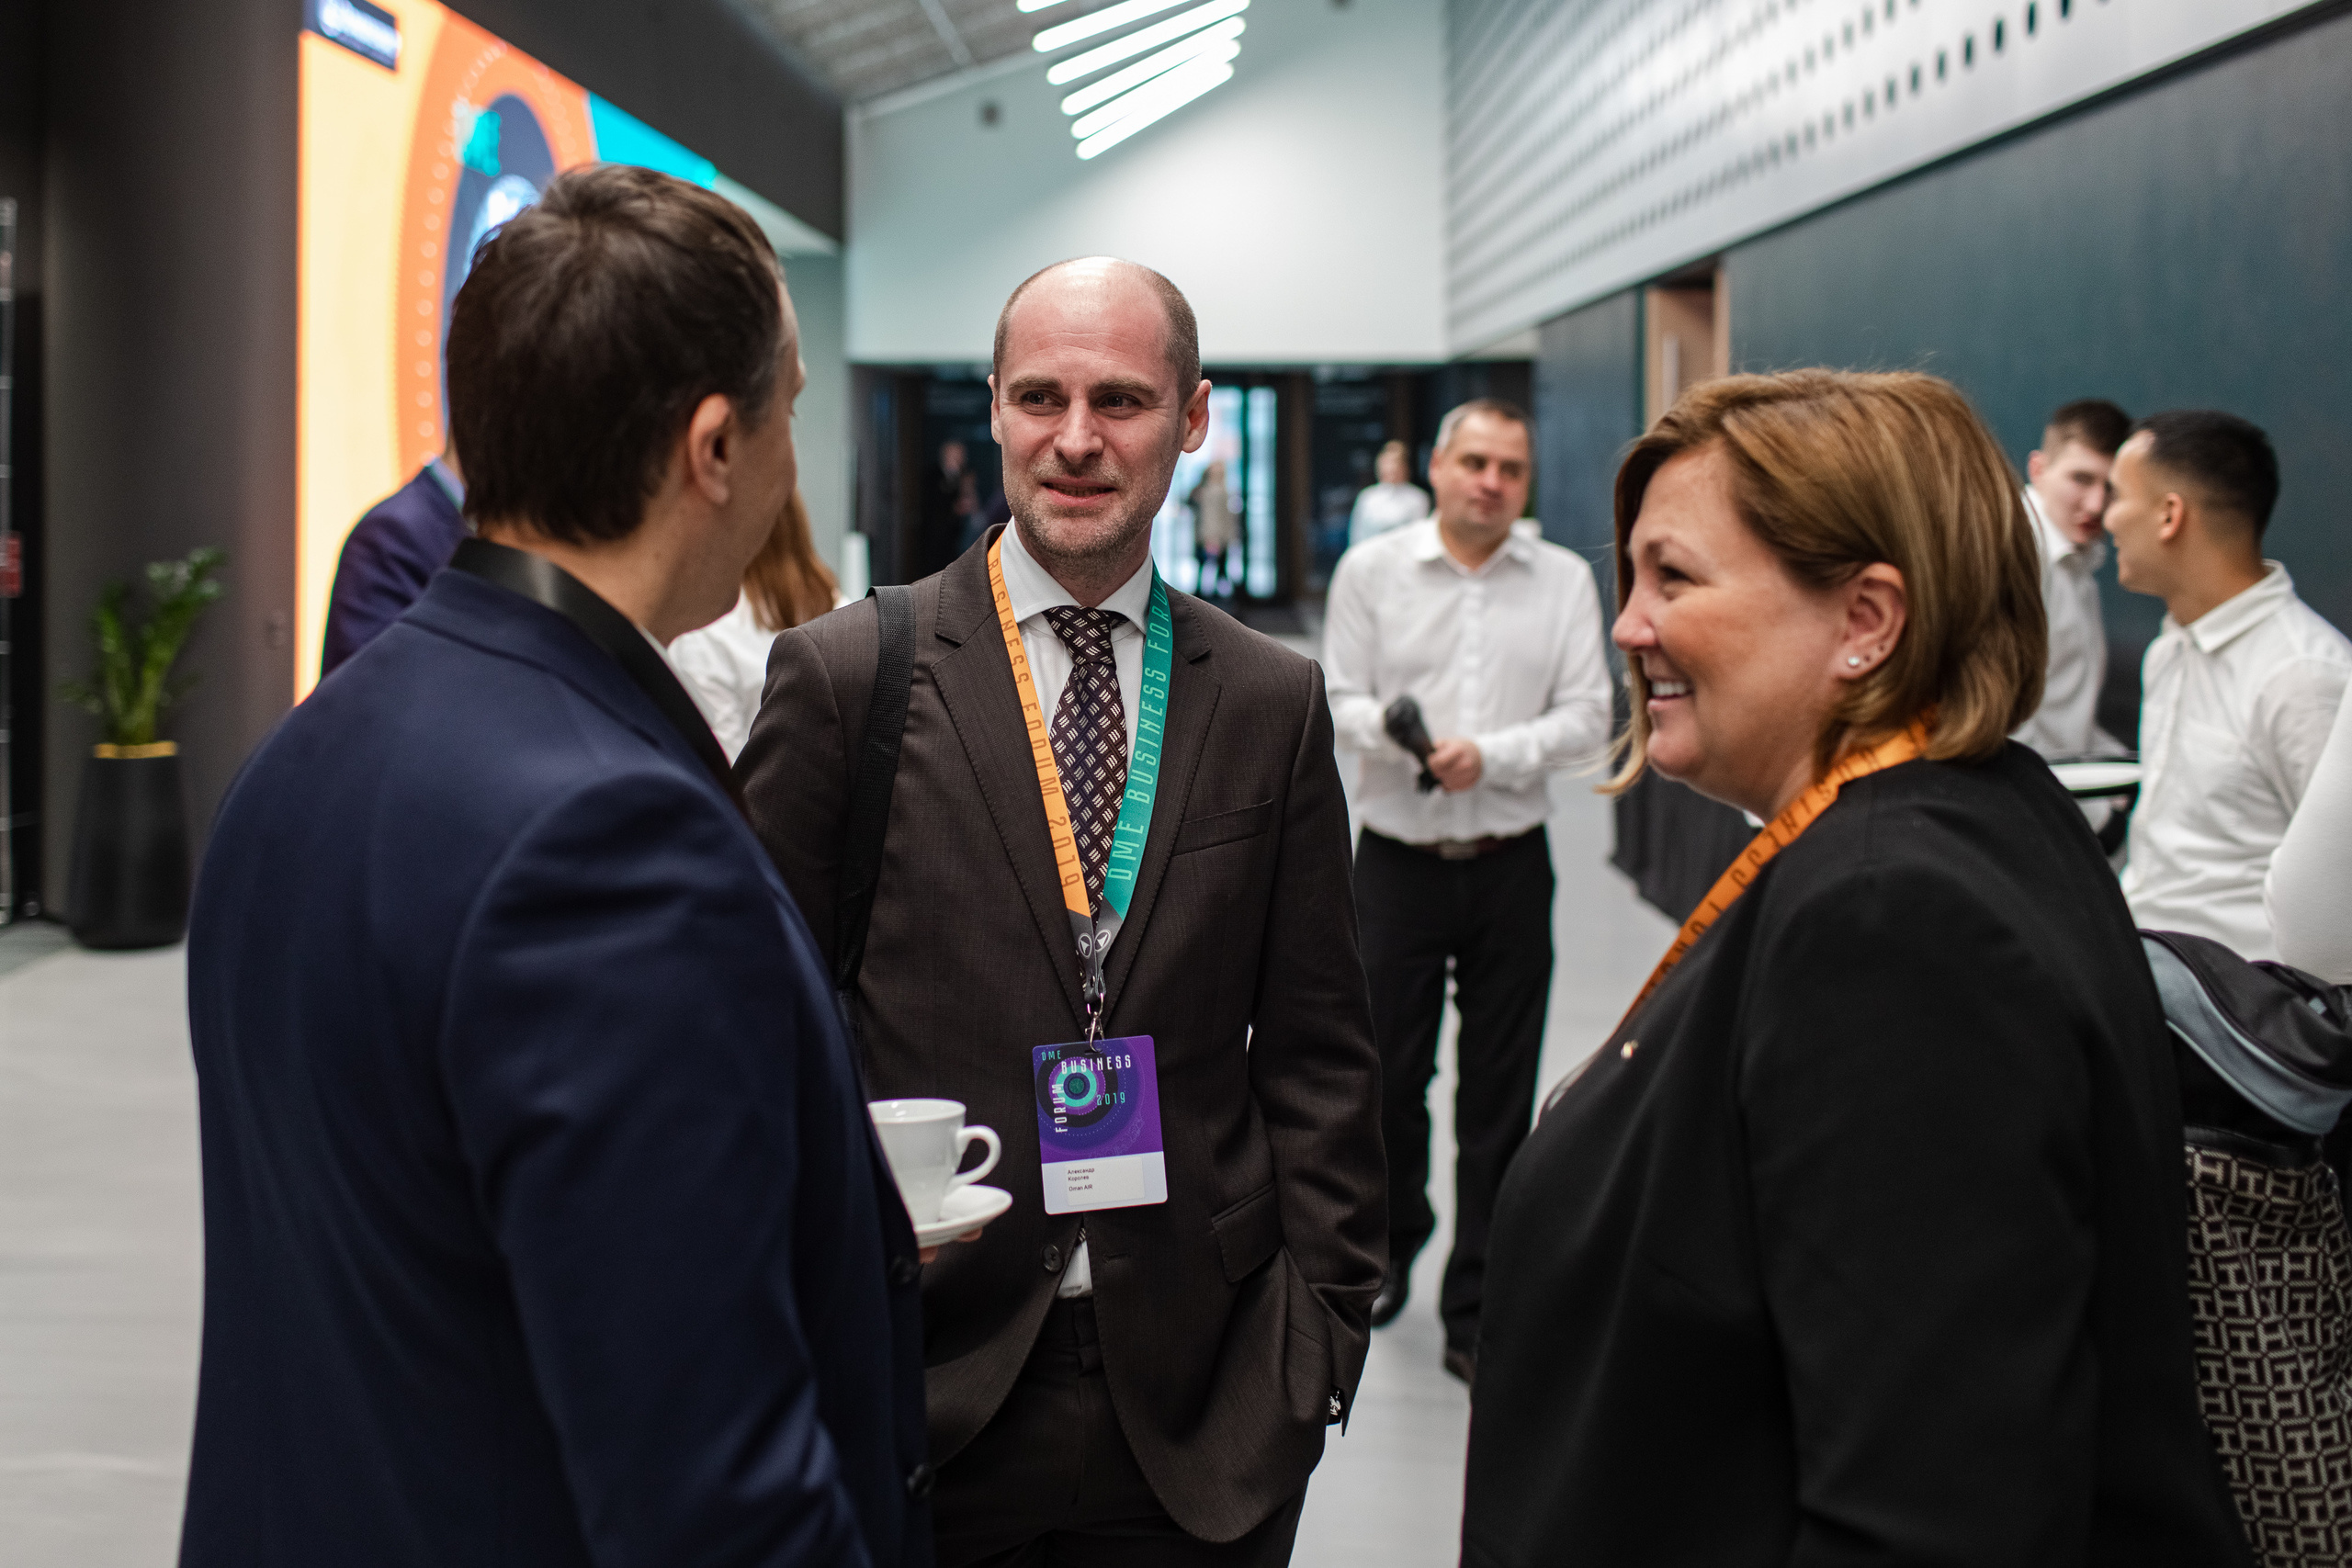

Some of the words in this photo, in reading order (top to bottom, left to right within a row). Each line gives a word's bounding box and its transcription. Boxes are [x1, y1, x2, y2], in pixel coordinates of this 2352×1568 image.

[1125, 667, 1168, 805] BUSINESS
[1048, 816, 1080, 888] 2019
[1061, 1055, 1131, 1075] BUSINESS
[1051, 1083, 1069, 1133] FORUM
[1096, 1091, 1125, 1106] 2019
